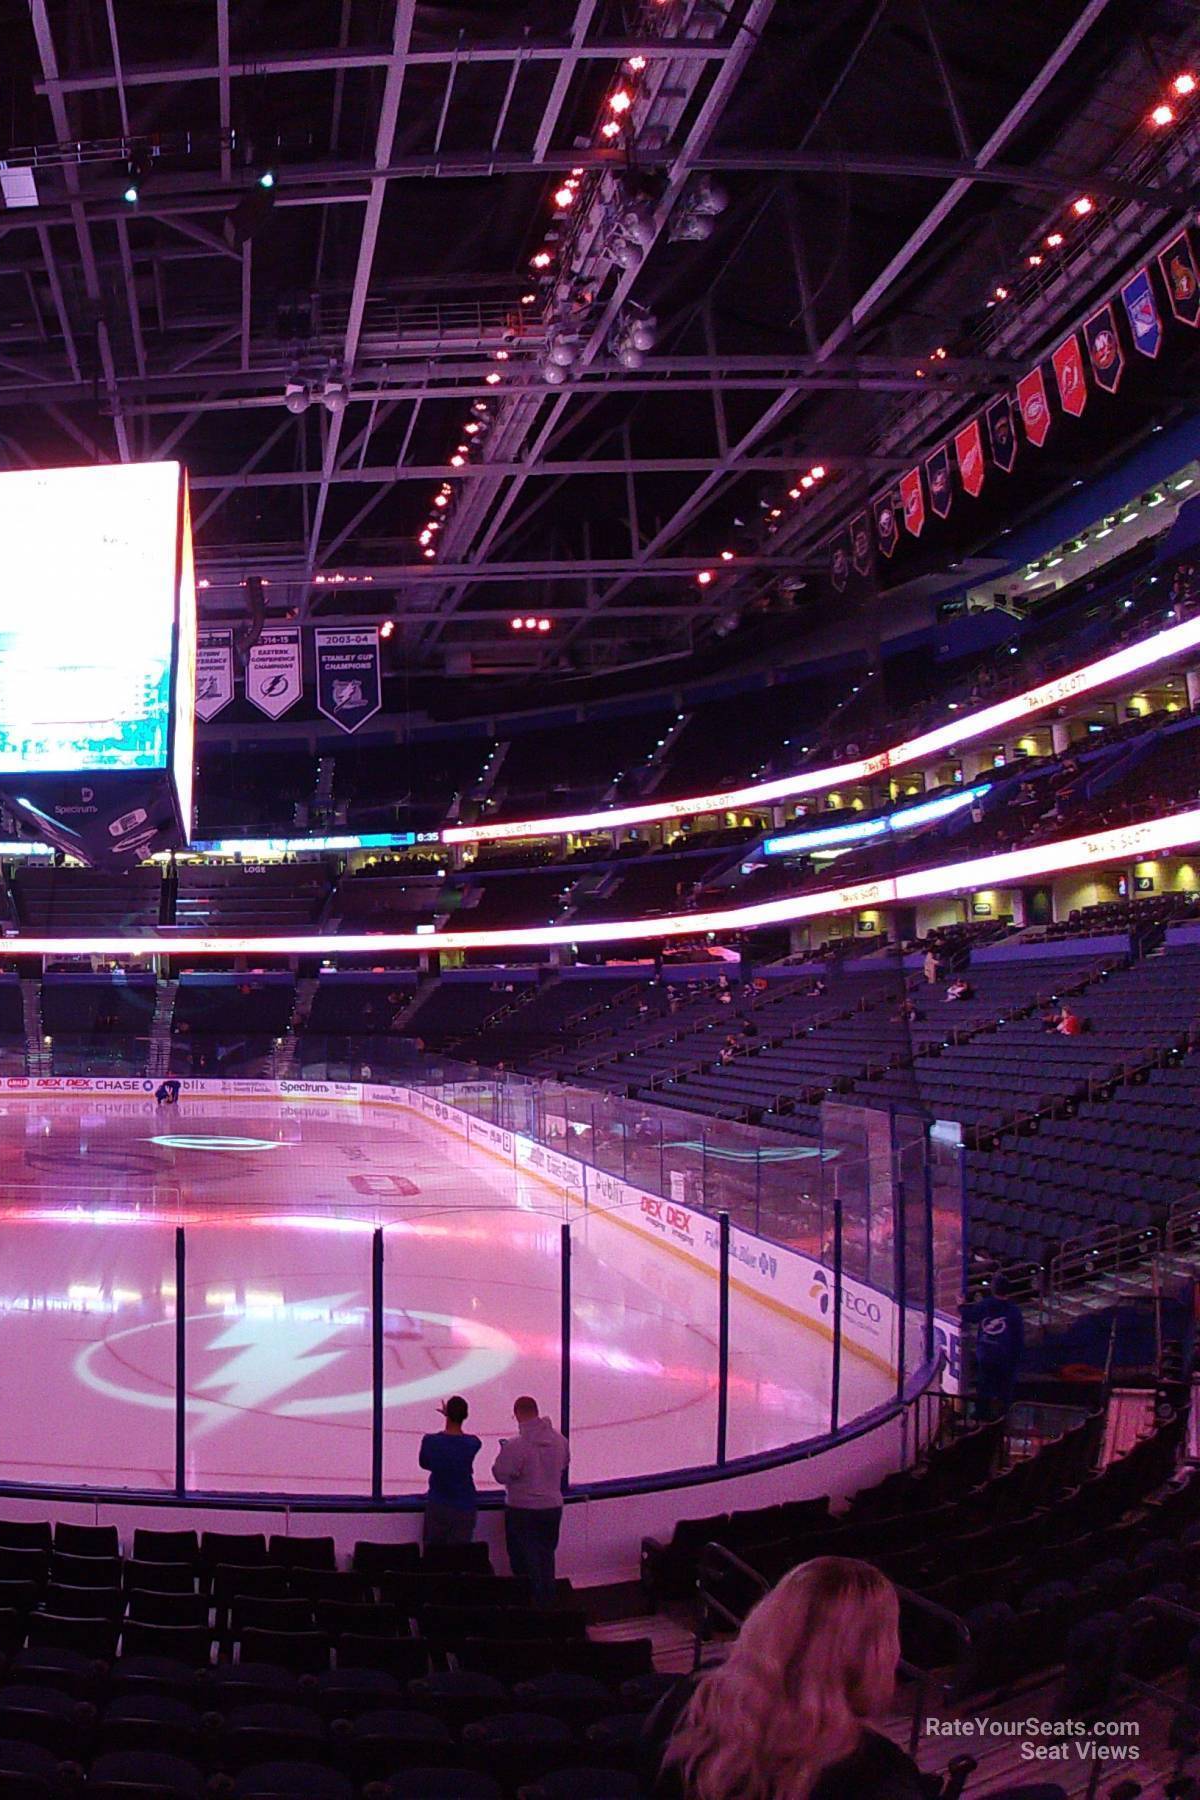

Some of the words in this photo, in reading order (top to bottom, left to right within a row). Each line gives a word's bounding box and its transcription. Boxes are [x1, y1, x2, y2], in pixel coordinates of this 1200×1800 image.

[326, 635, 369, 644] 2003-04
[324, 662, 372, 670] CHAMPIONS
[36, 1079, 62, 1087] DEX
[66, 1079, 91, 1087] DEX
[95, 1080, 140, 1090] CHASE
[280, 1081, 327, 1093] Spectrum
[641, 1196, 664, 1221] DEX
[666, 1205, 692, 1233] DEX
